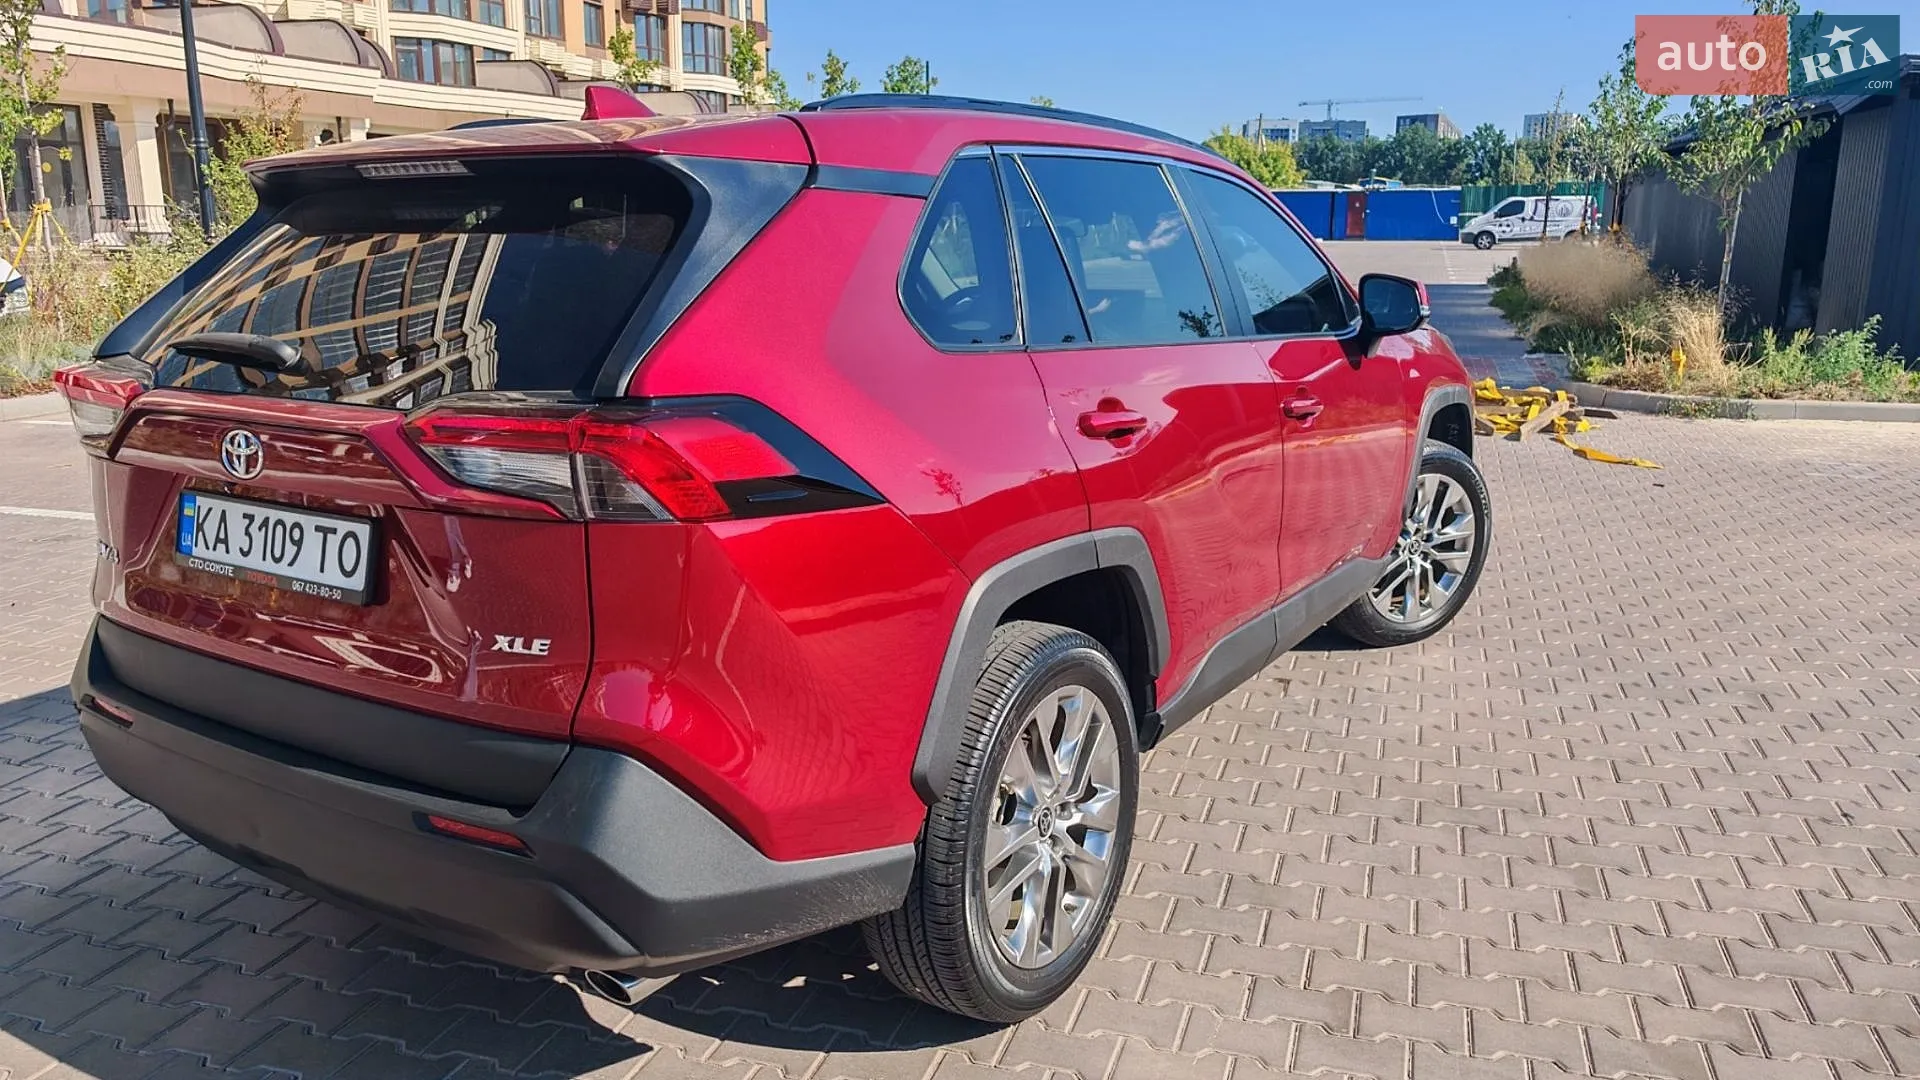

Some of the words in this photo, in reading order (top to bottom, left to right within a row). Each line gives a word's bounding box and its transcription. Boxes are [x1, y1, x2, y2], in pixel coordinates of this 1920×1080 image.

[195, 505, 230, 554] KA
[239, 513, 304, 567] 3109
[314, 525, 362, 579] TO
[204, 561, 235, 577] COYOTE
[490, 634, 552, 656] XLE
